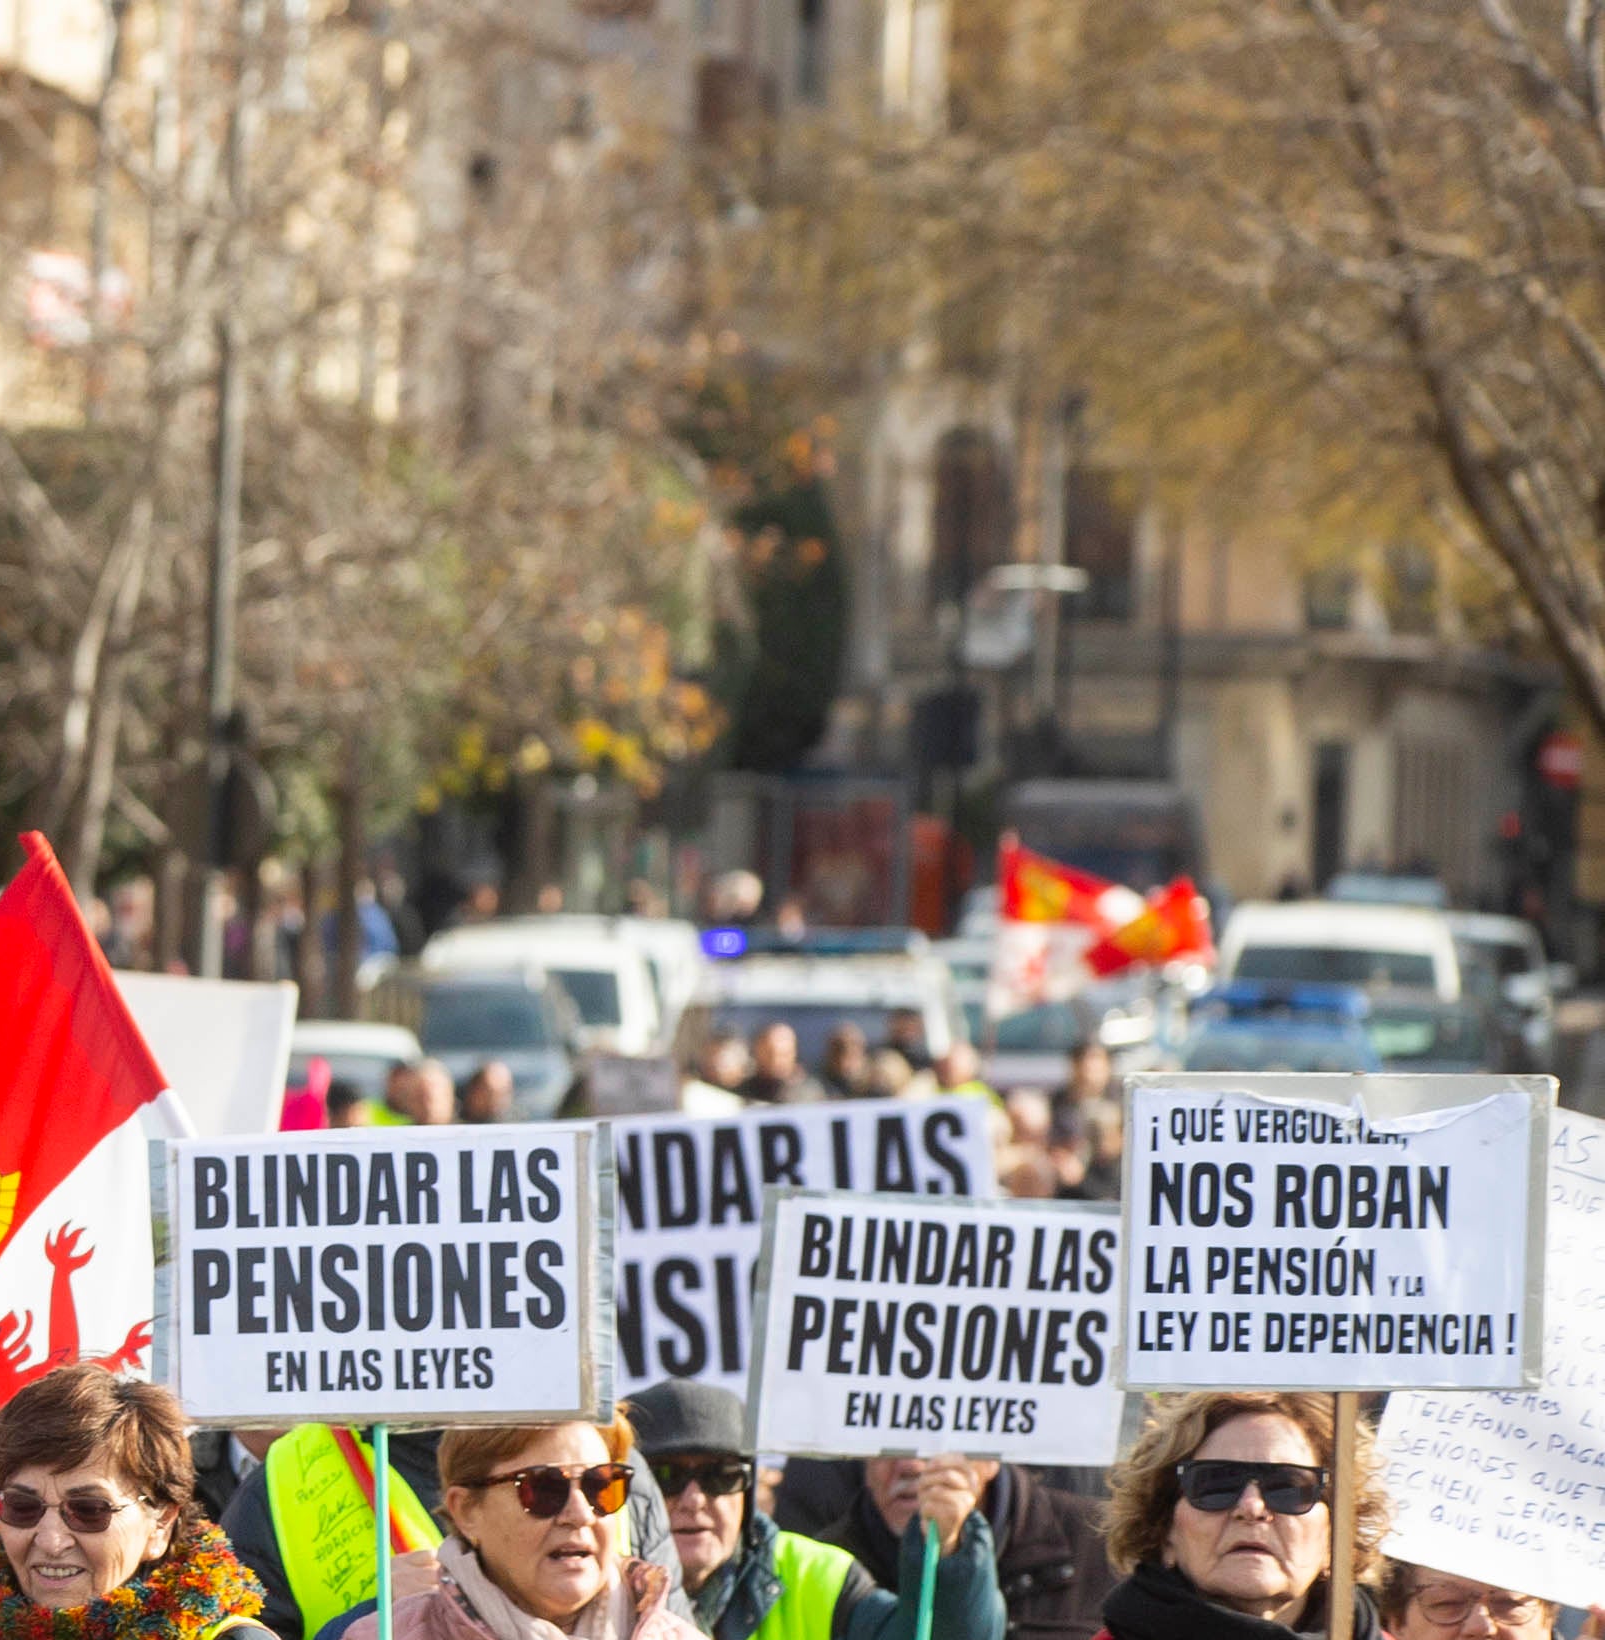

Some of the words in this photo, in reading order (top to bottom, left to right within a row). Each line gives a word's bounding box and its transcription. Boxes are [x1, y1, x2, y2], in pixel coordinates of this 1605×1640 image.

[1170, 1099, 1225, 1145] QUÉ
[193, 1151, 440, 1230] BLINDAR
[458, 1147, 562, 1224] LAS
[1149, 1161, 1255, 1228] NOS
[1275, 1164, 1451, 1230] ROBAN
[798, 1213, 1015, 1290] BLINDAR
[1027, 1226, 1117, 1295] LAS
[1144, 1246, 1190, 1295] LA
[1206, 1236, 1376, 1297] PENSIÓN
[1387, 1275, 1400, 1297] Y
[1404, 1275, 1426, 1297] LA
[192, 1239, 567, 1336] PENSIONES
[786, 1294, 1109, 1387] PENSIONES
[1137, 1310, 1199, 1353] LEY
[1209, 1311, 1250, 1353] DE
[1263, 1311, 1495, 1356] DEPENDENCIA
[266, 1350, 308, 1393] EN
[319, 1348, 383, 1392] LAS
[394, 1346, 495, 1391] LEYES
[844, 1390, 883, 1428] EN
[888, 1394, 945, 1432] LAS
[952, 1397, 1038, 1435] LEYES
